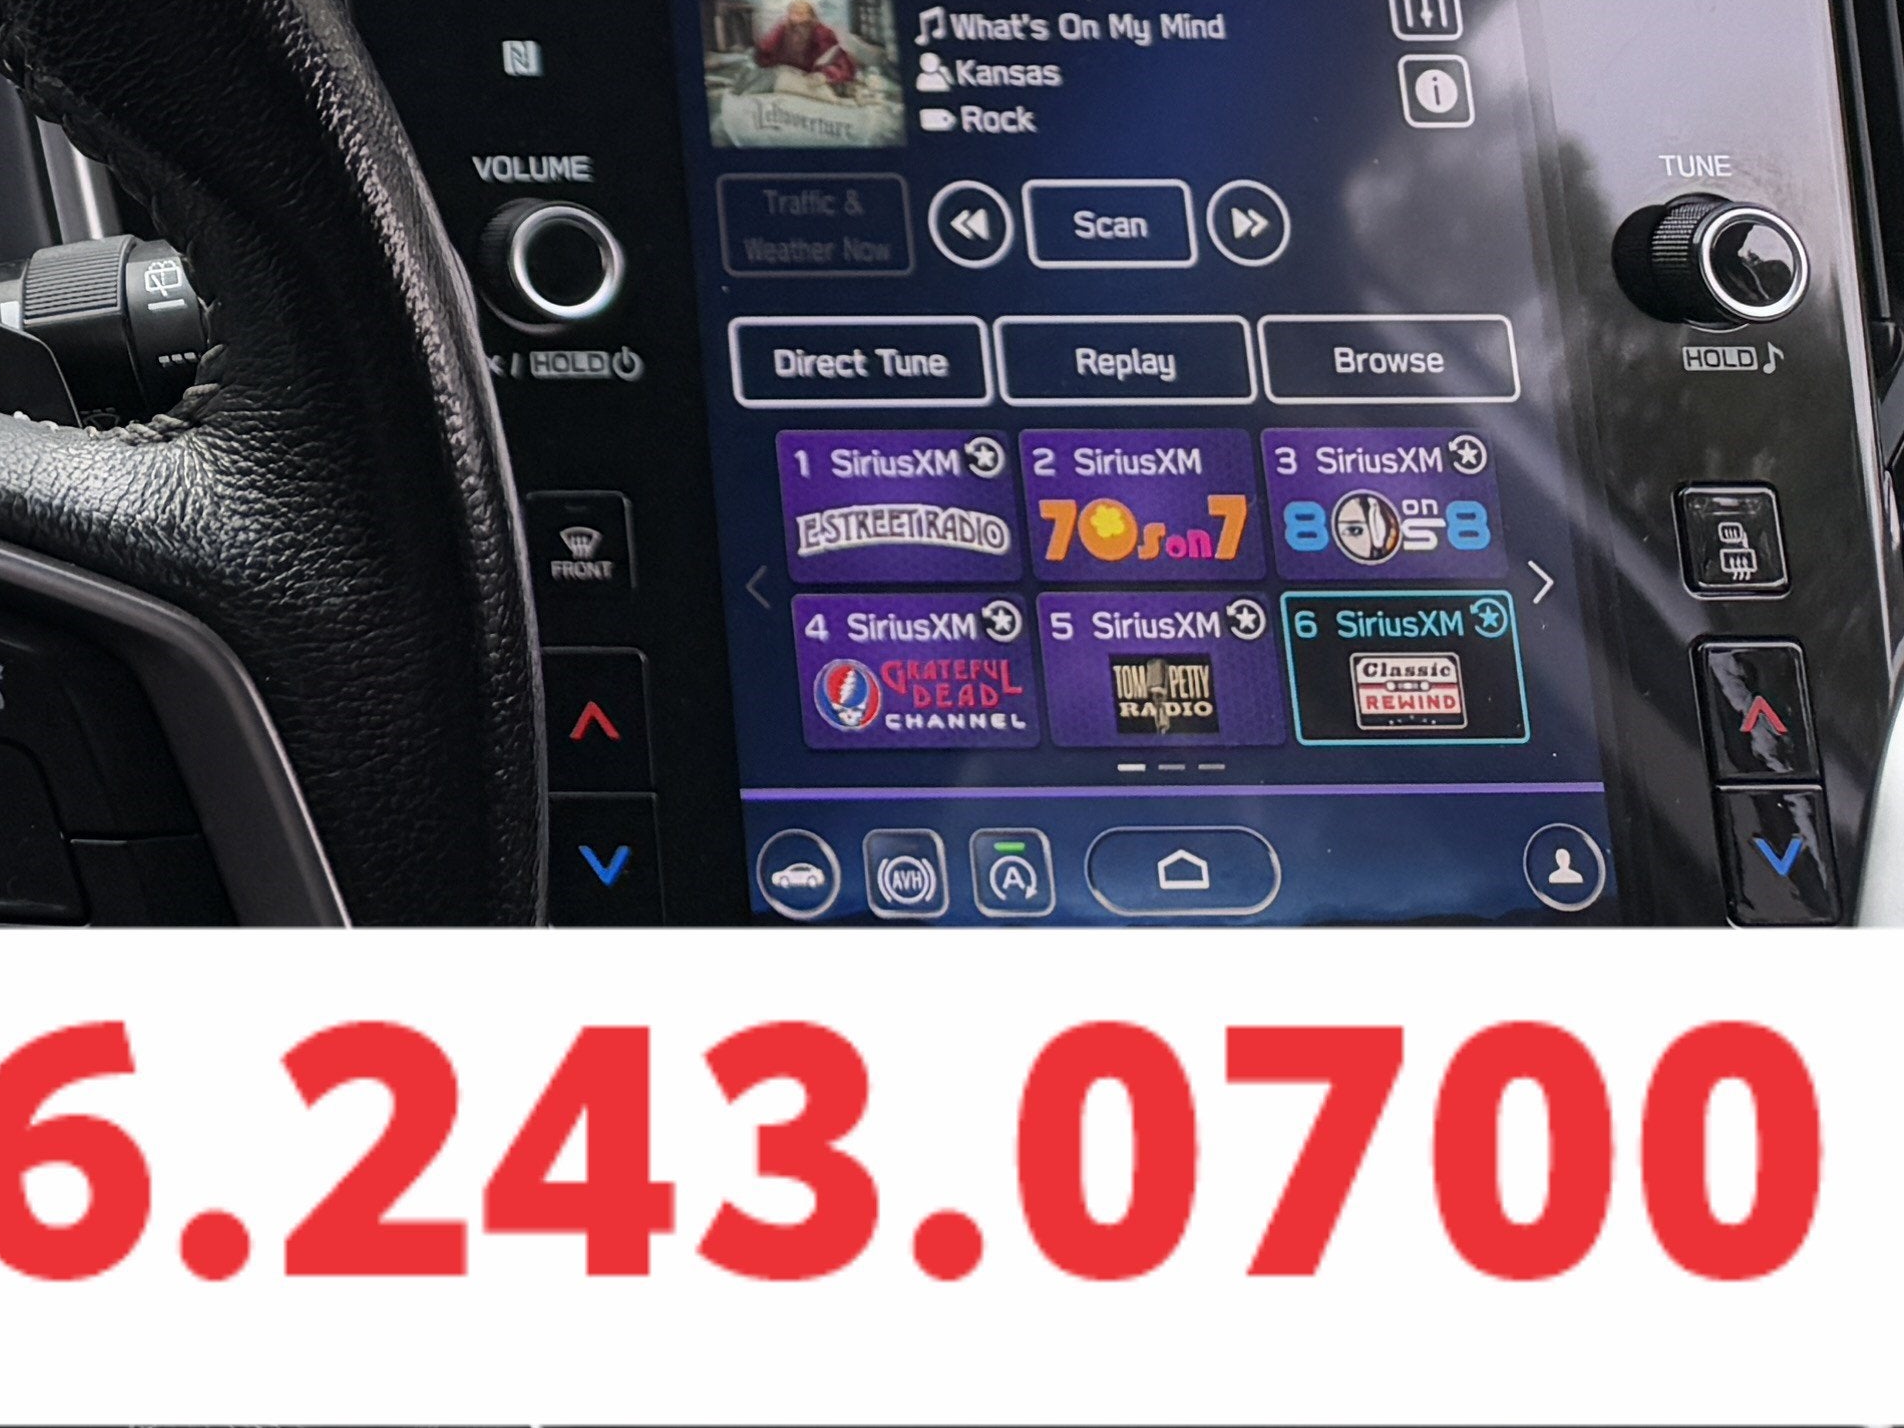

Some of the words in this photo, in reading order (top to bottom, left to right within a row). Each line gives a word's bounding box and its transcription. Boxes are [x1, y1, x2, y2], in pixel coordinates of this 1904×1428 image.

[951, 13, 1050, 41] What's
[1059, 14, 1099, 41] On
[1110, 13, 1152, 47] My
[1161, 13, 1227, 41] Mind
[955, 60, 1062, 88] Kansas
[961, 106, 1038, 135] Rock
[472, 155, 593, 182] VOLUME
[1658, 155, 1732, 177] TUNE
[763, 189, 837, 217] Traffic
[844, 191, 863, 216] &
[1073, 211, 1149, 240] Scan
[744, 237, 834, 264] Weather
[843, 237, 892, 265] Now
[532, 352, 606, 374] HOLD
[774, 349, 865, 378] Direct
[874, 349, 950, 378] Tune
[1075, 349, 1177, 383] Replay
[1334, 346, 1445, 376] Browse
[1685, 349, 1754, 368] HOLD
[794, 450, 811, 478] 1
[831, 449, 960, 478] SiriusXM
[1033, 448, 1056, 477] 2
[1073, 448, 1203, 476] SiriusXM
[1275, 447, 1297, 475] 3
[1316, 447, 1443, 475] SiriusXM
[551, 561, 613, 580] FRONT
[804, 614, 829, 642] 4
[847, 613, 978, 642] SiriusXM
[1051, 612, 1073, 640] 5
[1092, 611, 1220, 640] SiriusXM
[1294, 611, 1317, 638] 6
[1336, 611, 1464, 637] SiriusXM
[1168, 665, 1210, 699] PETTY
[1362, 663, 1452, 677] Classic
[913, 683, 999, 708] DEAD
[1119, 701, 1213, 717] RADIO
[1365, 694, 1456, 710] REWIND
[884, 713, 1026, 730] CHANNEL
[891, 871, 922, 891] AVH
